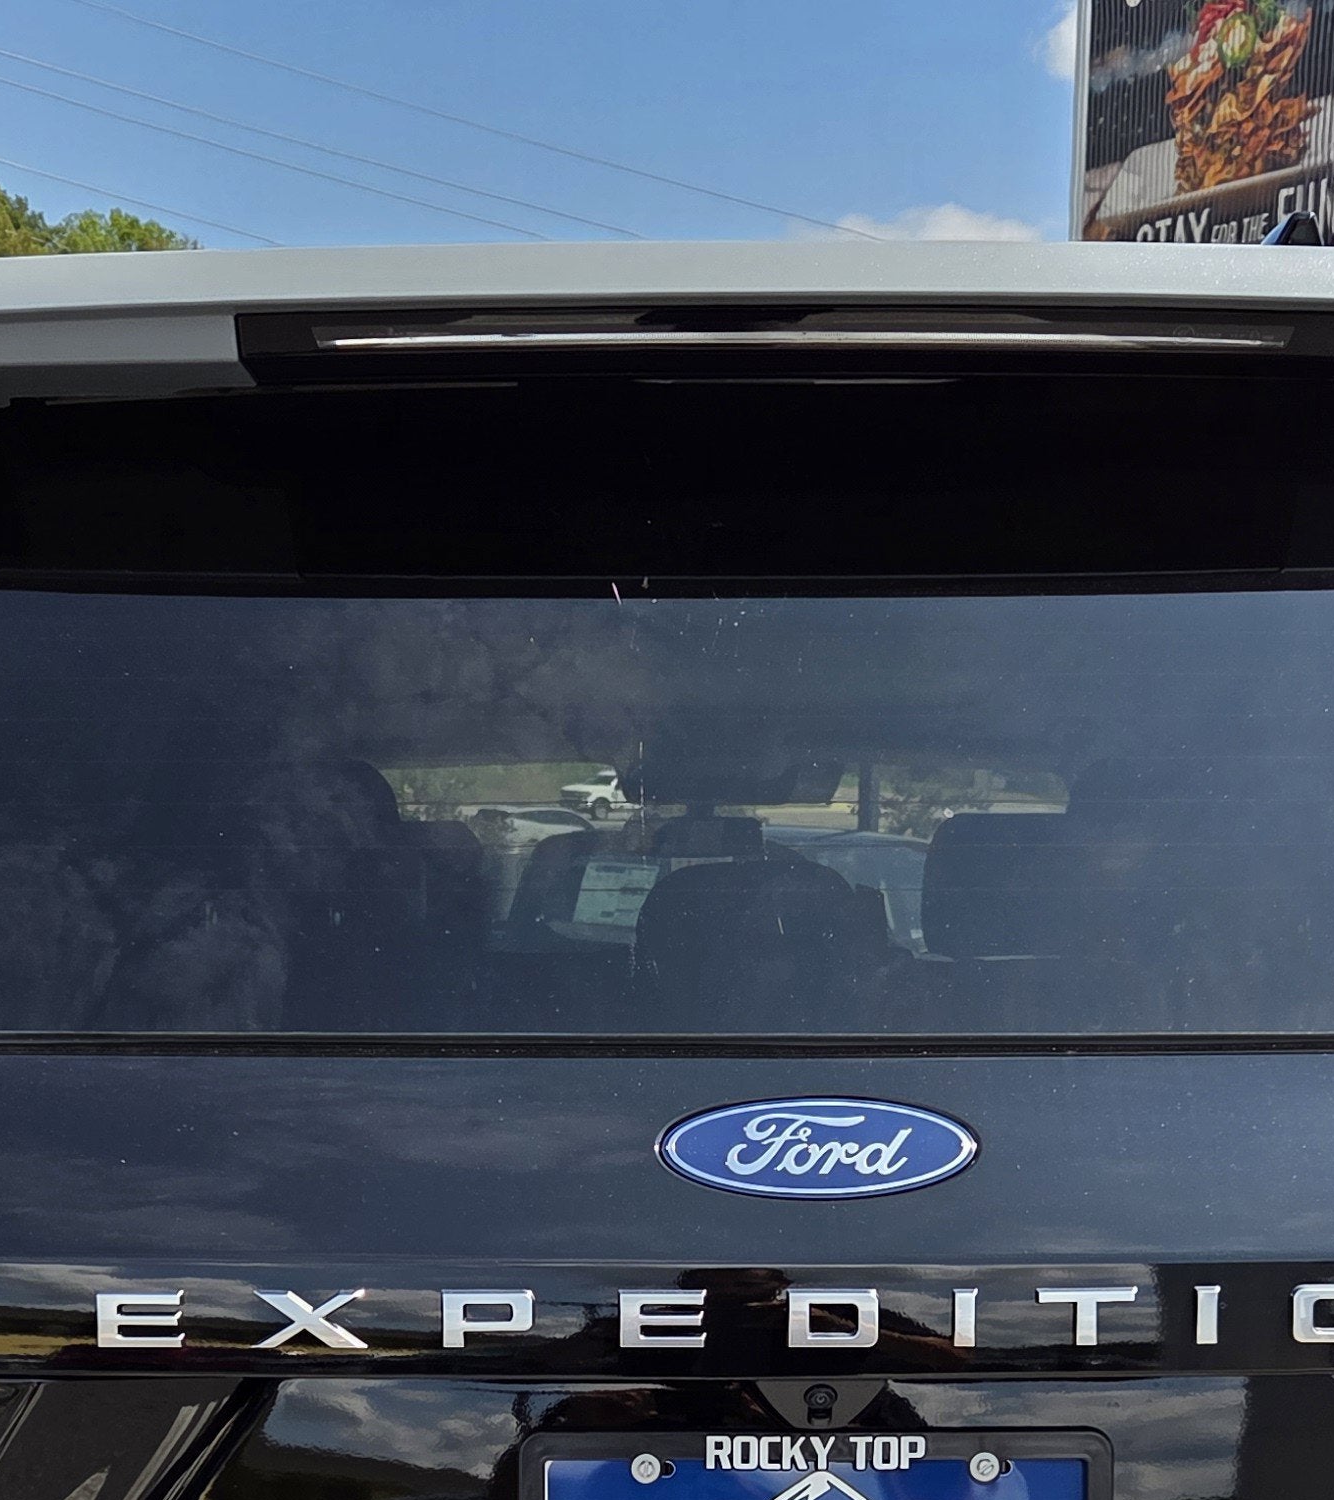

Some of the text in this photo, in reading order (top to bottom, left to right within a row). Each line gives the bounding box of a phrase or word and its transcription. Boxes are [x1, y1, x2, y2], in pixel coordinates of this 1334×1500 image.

[1242, 212, 1270, 243] THE
[726, 1113, 912, 1179] Ford
[705, 1434, 926, 1471] ROCKY TOP
